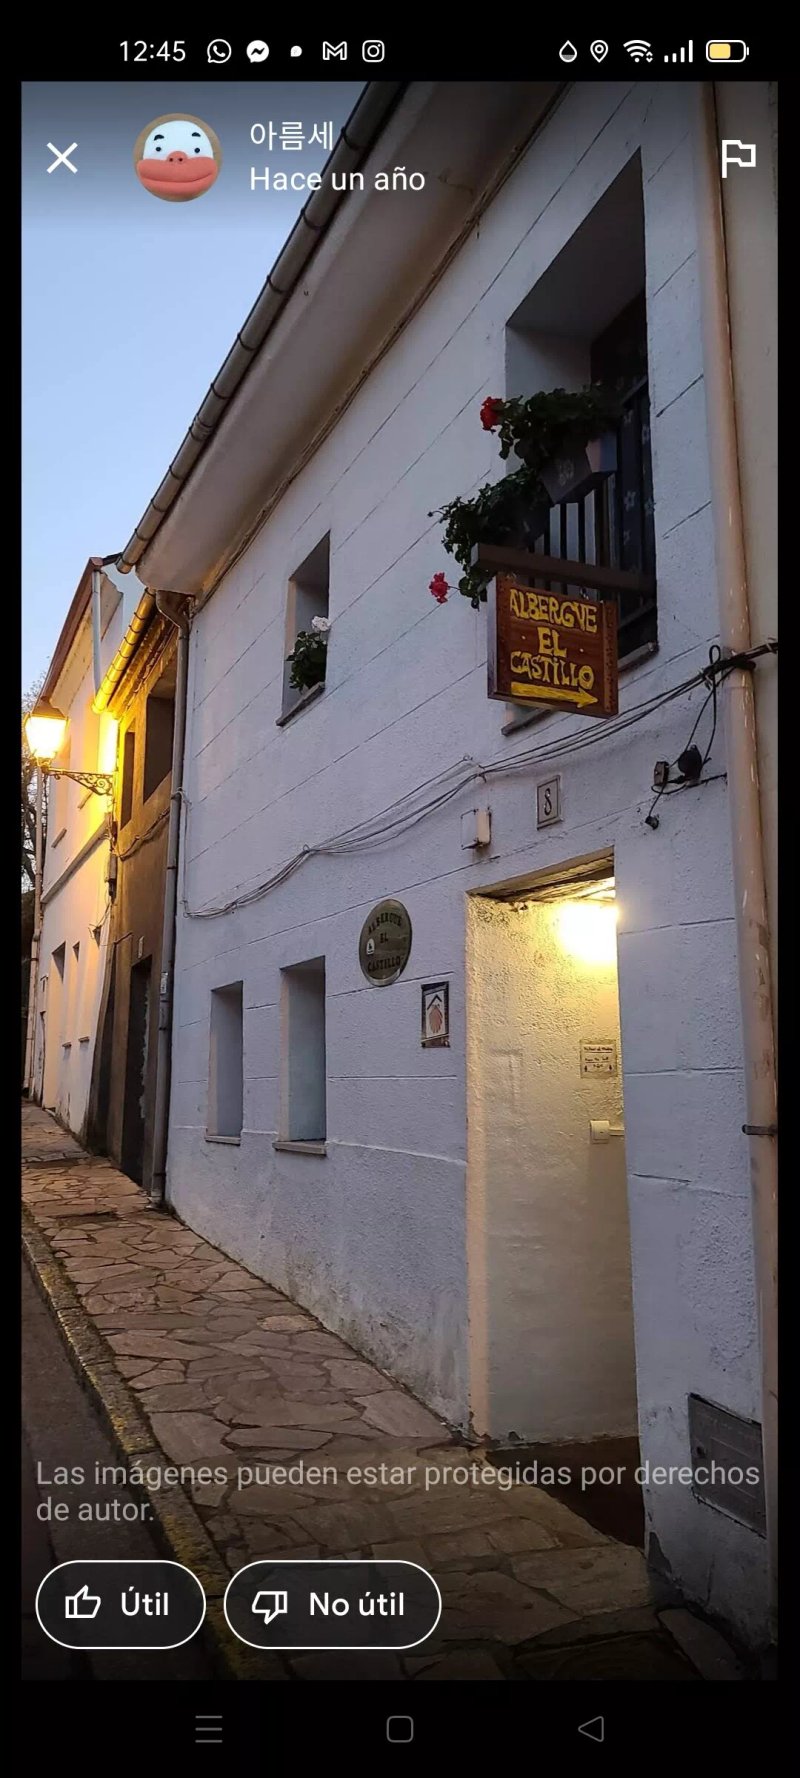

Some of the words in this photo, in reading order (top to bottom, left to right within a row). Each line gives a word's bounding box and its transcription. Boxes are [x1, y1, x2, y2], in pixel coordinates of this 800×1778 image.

[537, 627, 567, 658] EL
[380, 933, 389, 943] EL
[367, 956, 401, 972] CASTILLO
